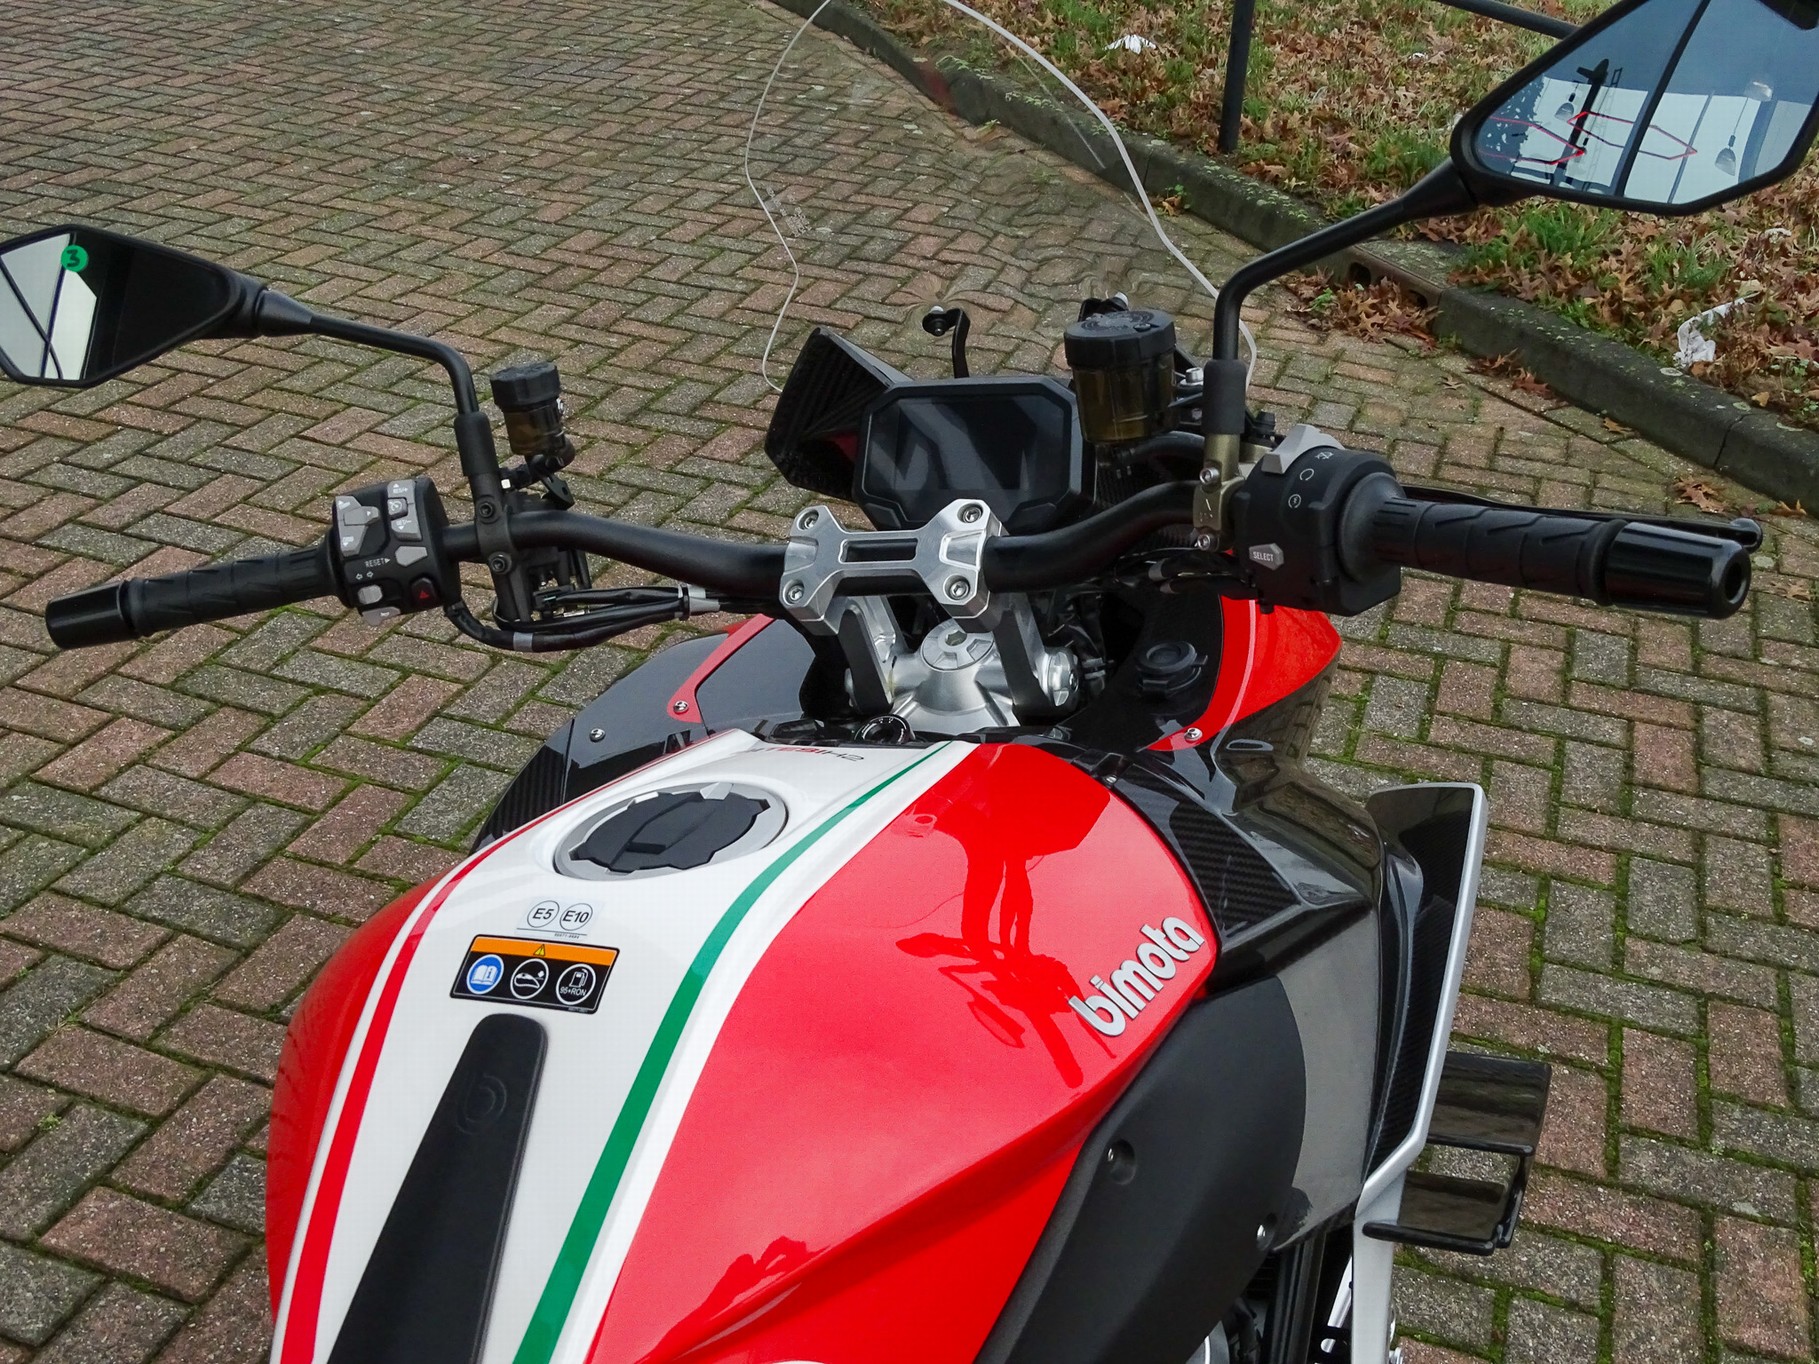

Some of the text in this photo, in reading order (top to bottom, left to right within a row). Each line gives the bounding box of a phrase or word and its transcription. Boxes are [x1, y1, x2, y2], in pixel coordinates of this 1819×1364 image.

[67, 249, 80, 267] 3
[365, 558, 385, 567] RESET
[1252, 551, 1274, 562] SELECT
[532, 908, 589, 924] E5 E10
[1068, 916, 1205, 1036] bimota
